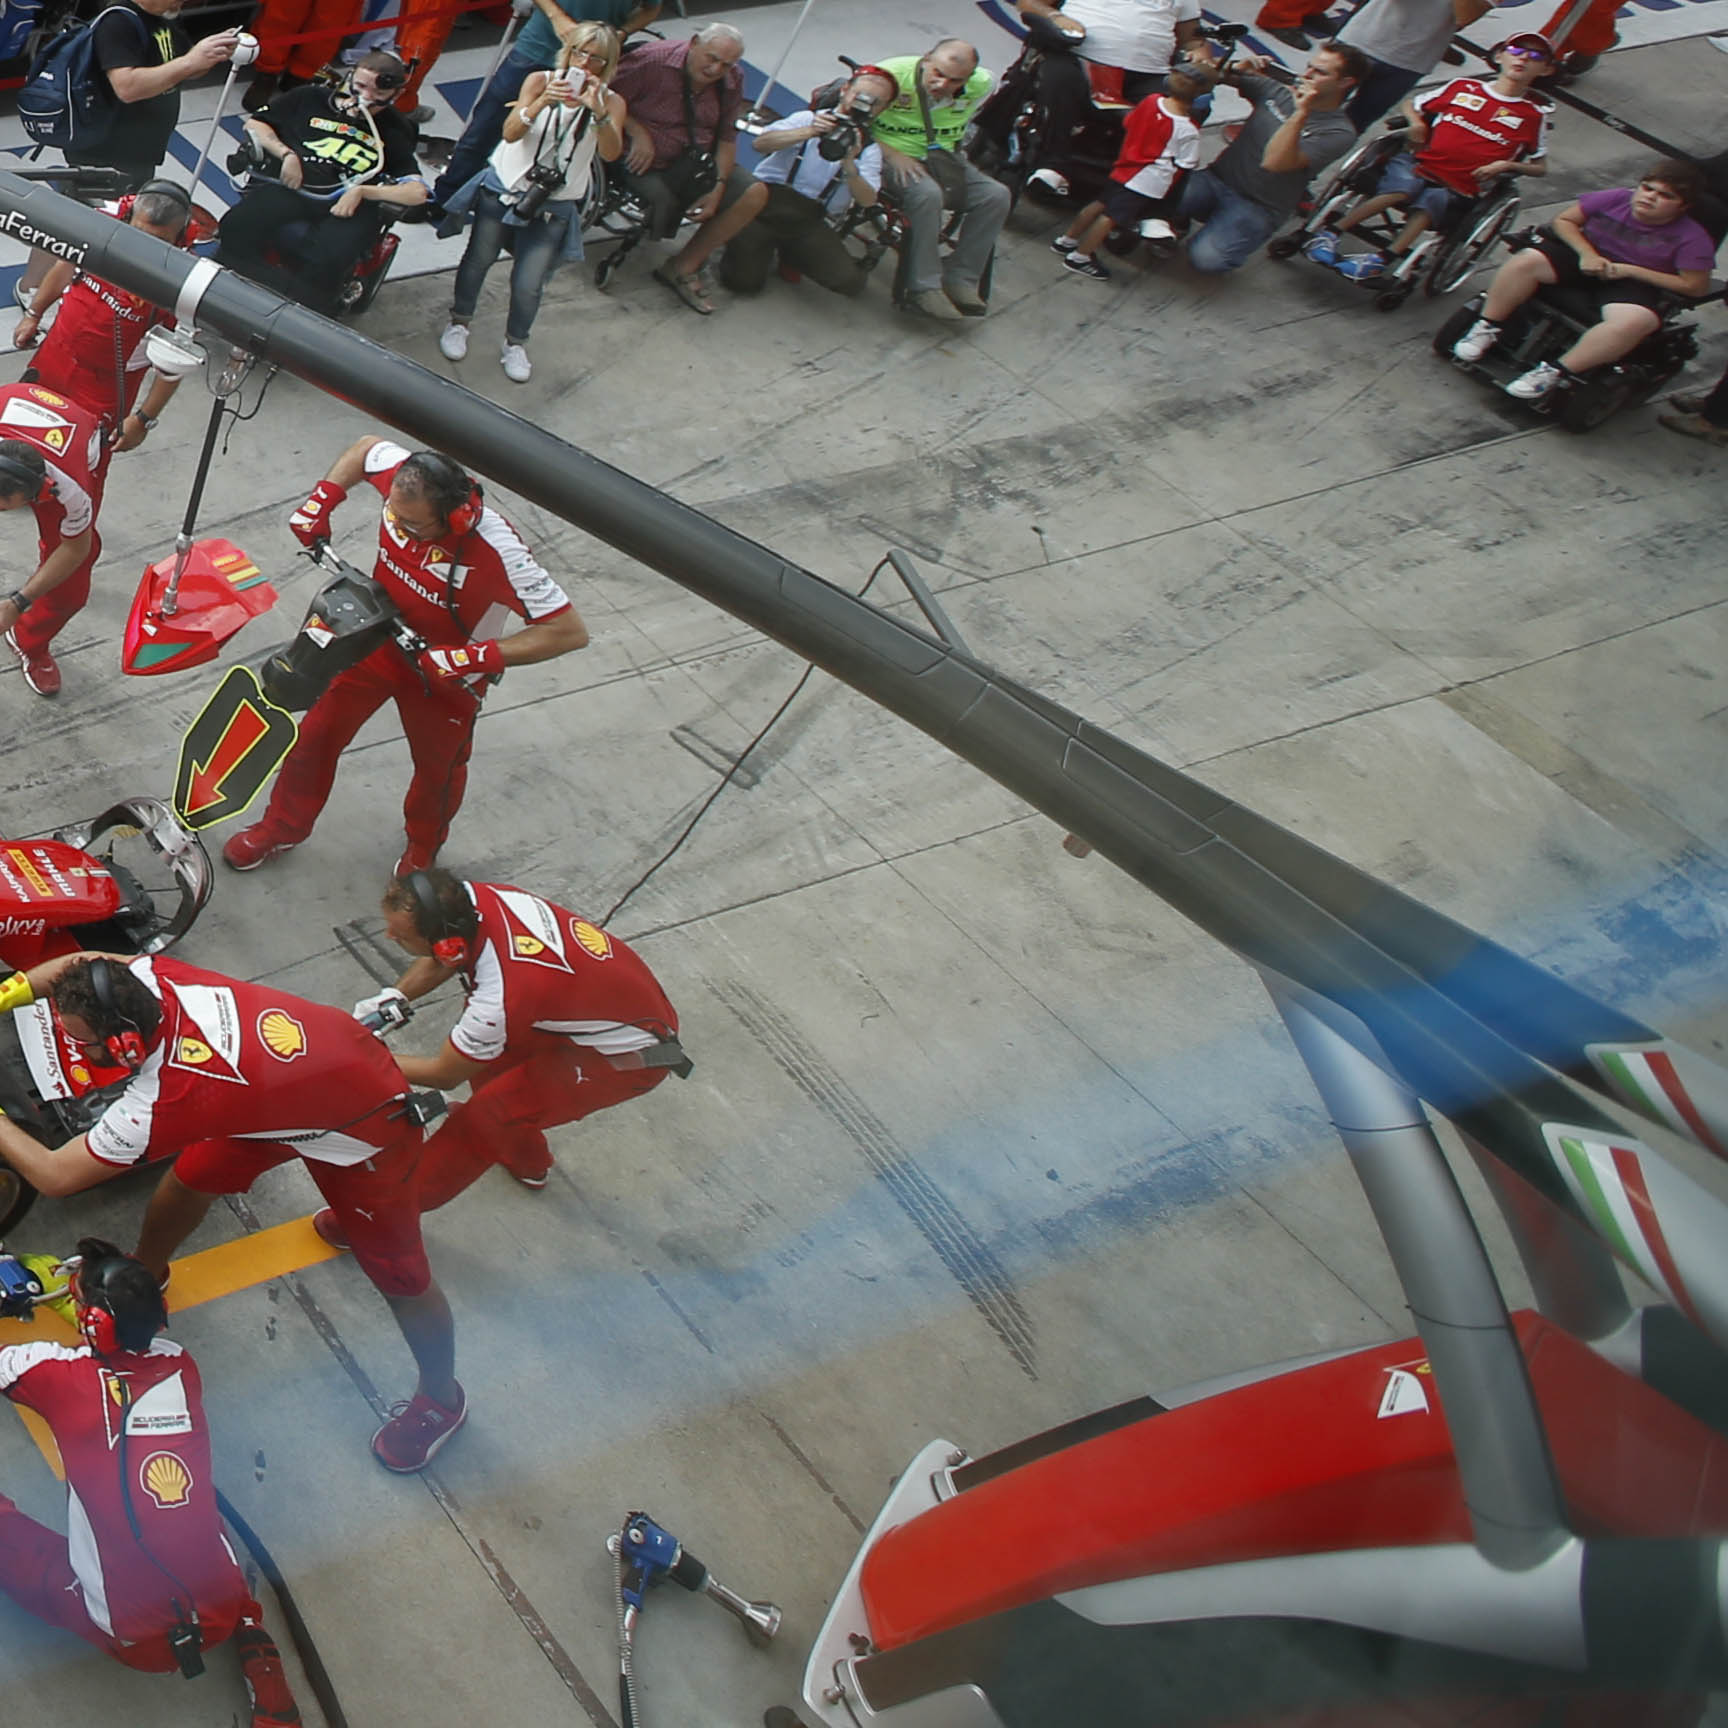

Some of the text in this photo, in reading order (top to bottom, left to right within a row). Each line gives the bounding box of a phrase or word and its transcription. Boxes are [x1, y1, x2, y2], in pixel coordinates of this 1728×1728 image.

[1451, 115, 1511, 146] Santander
[303, 137, 379, 172] 46
[35, 1002, 61, 1079] Santander
